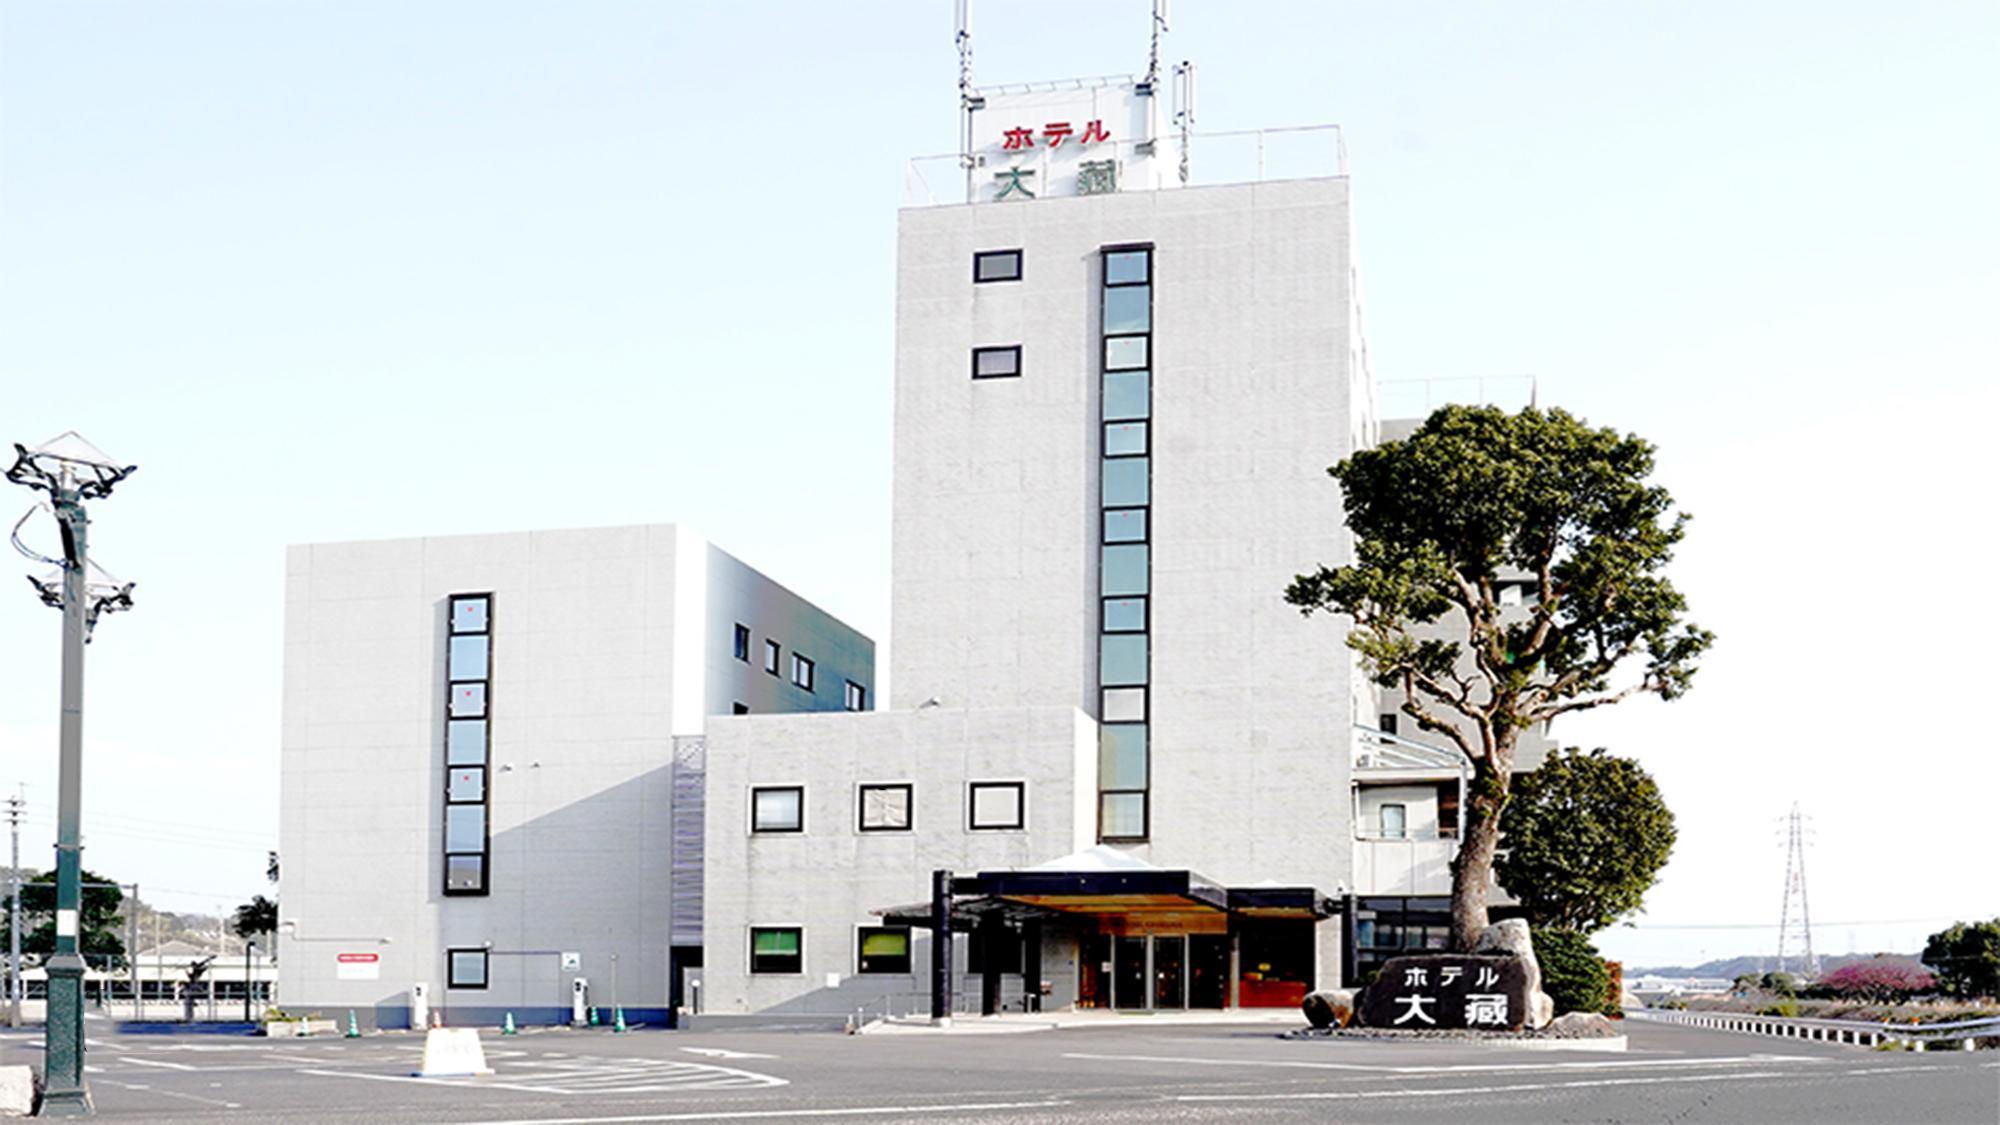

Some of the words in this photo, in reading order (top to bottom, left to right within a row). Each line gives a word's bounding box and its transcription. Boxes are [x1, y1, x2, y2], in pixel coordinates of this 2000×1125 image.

[1003, 120, 1110, 149] ホテル
[1404, 967, 1500, 990] ホテル
